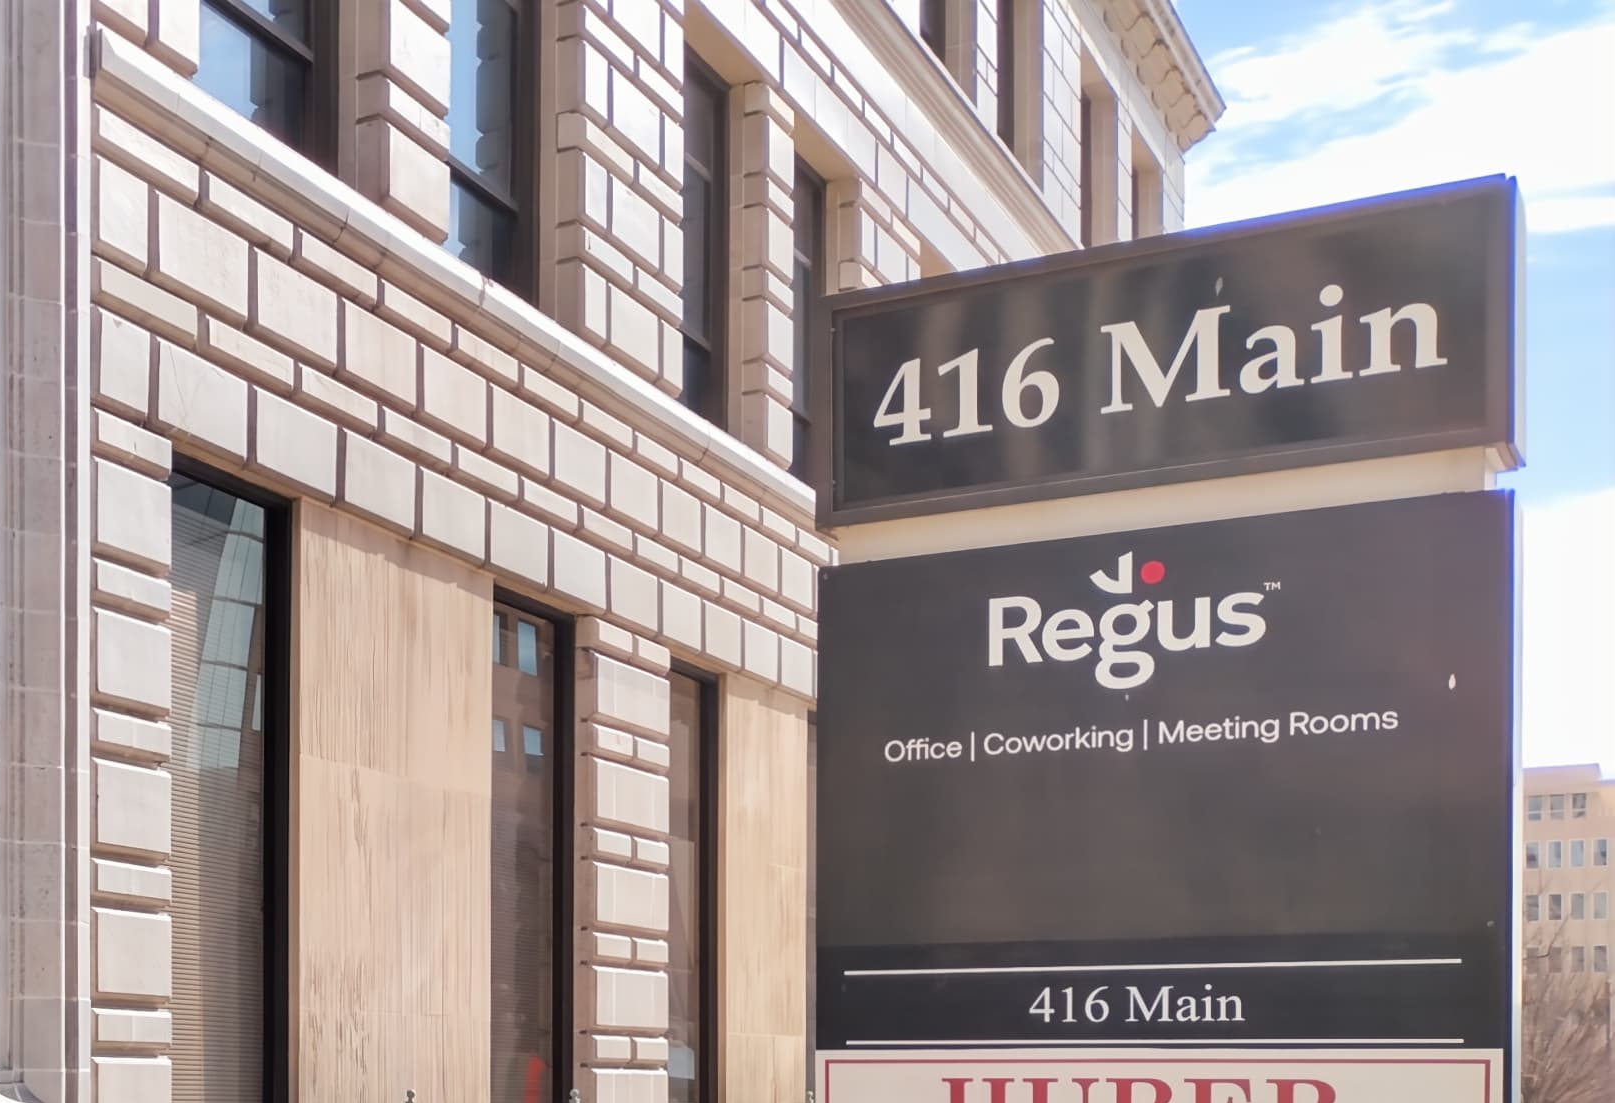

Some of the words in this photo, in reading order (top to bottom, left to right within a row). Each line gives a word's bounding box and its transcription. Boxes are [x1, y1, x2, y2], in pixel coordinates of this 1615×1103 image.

[873, 337, 1060, 446] 416
[1100, 284, 1448, 415] Main
[988, 591, 1267, 690] Regus
[884, 738, 963, 763] Office
[983, 723, 1134, 757] Coworking
[1158, 715, 1280, 746] Meeting
[1289, 709, 1399, 736] Rooms
[1028, 985, 1110, 1023] 416
[1125, 983, 1246, 1022] Main
